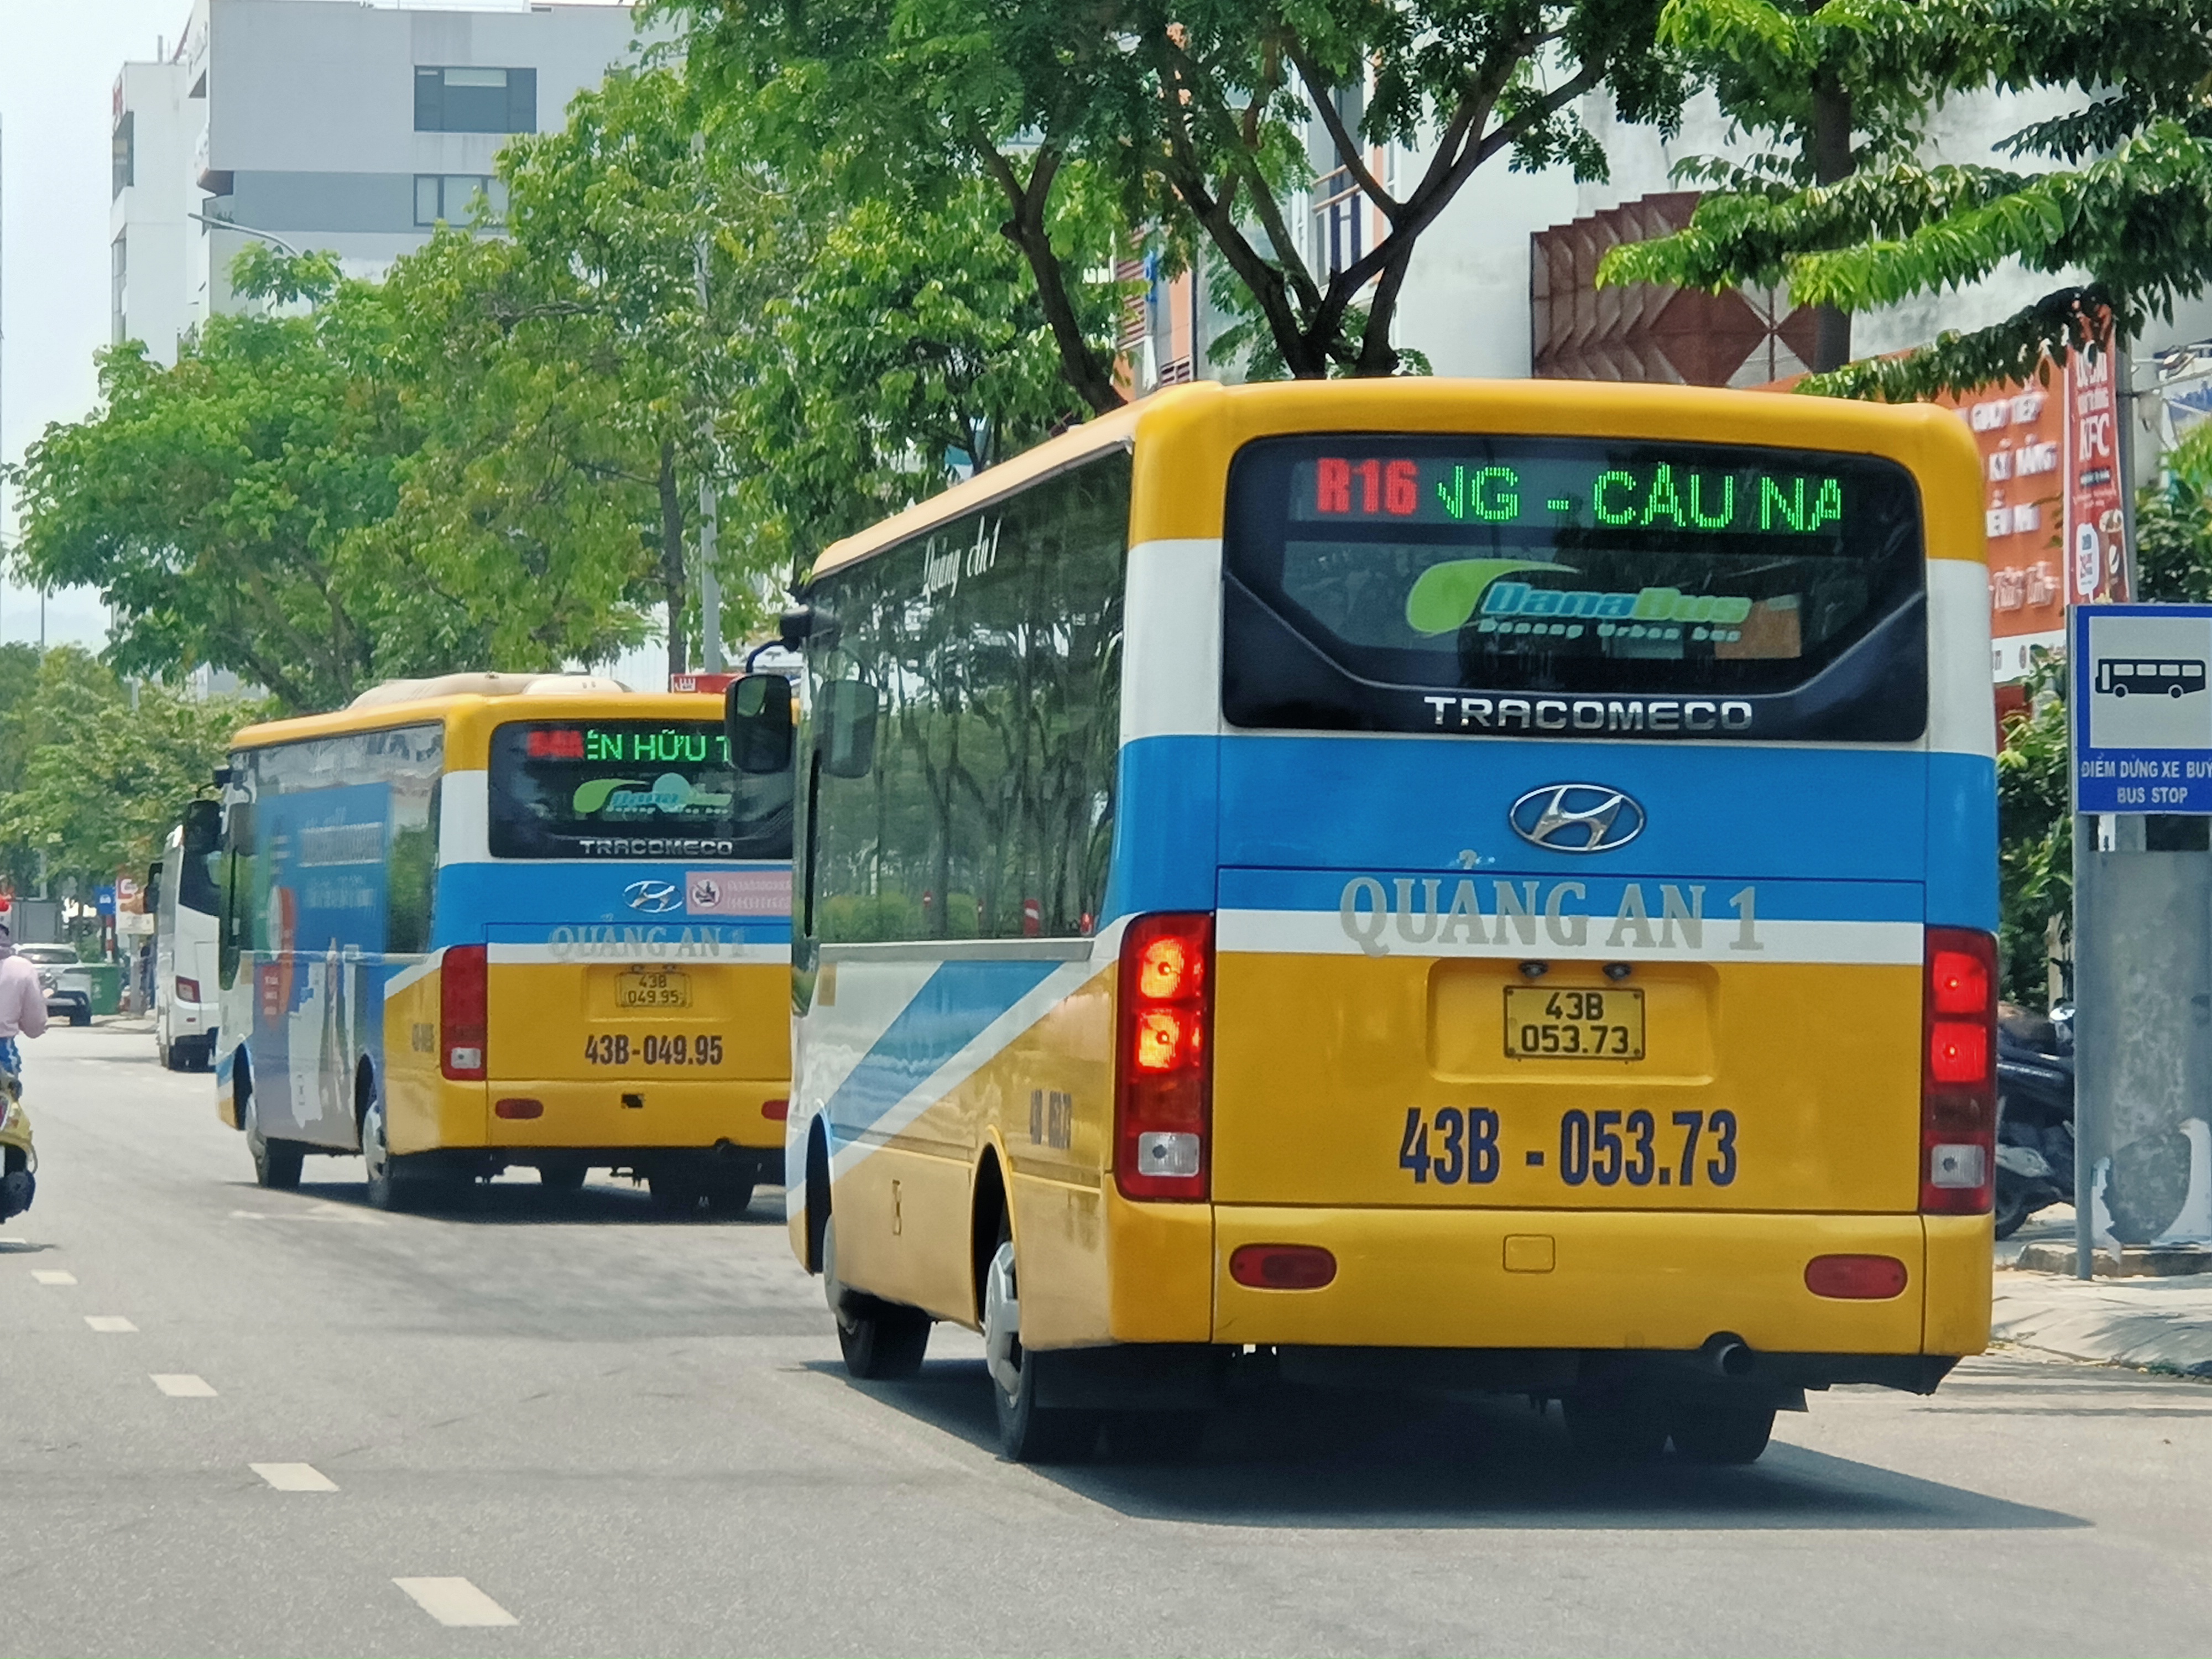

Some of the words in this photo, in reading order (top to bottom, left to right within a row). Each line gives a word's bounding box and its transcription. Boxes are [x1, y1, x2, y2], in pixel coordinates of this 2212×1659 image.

[2079, 413, 2110, 463] KFC
[1317, 457, 1418, 517] R16
[1424, 696, 1752, 731] TRACOMECO
[2081, 752, 2116, 778] ĐIỂM
[2161, 761, 2180, 779] XE
[2117, 787, 2146, 804] BUS
[2151, 787, 2188, 804] STOP
[580, 840, 733, 855] TRACOMECO
[1605, 883, 1707, 950] AN
[1729, 886, 1765, 951] 1
[674, 926, 721, 958] AN
[638, 974, 667, 988] 43B
[1545, 992, 1604, 1021] 43B
[1521, 1025, 1630, 1054] 053.73
[1399, 1107, 1500, 1185] 43B
[1559, 1108, 1738, 1187] 053.73
